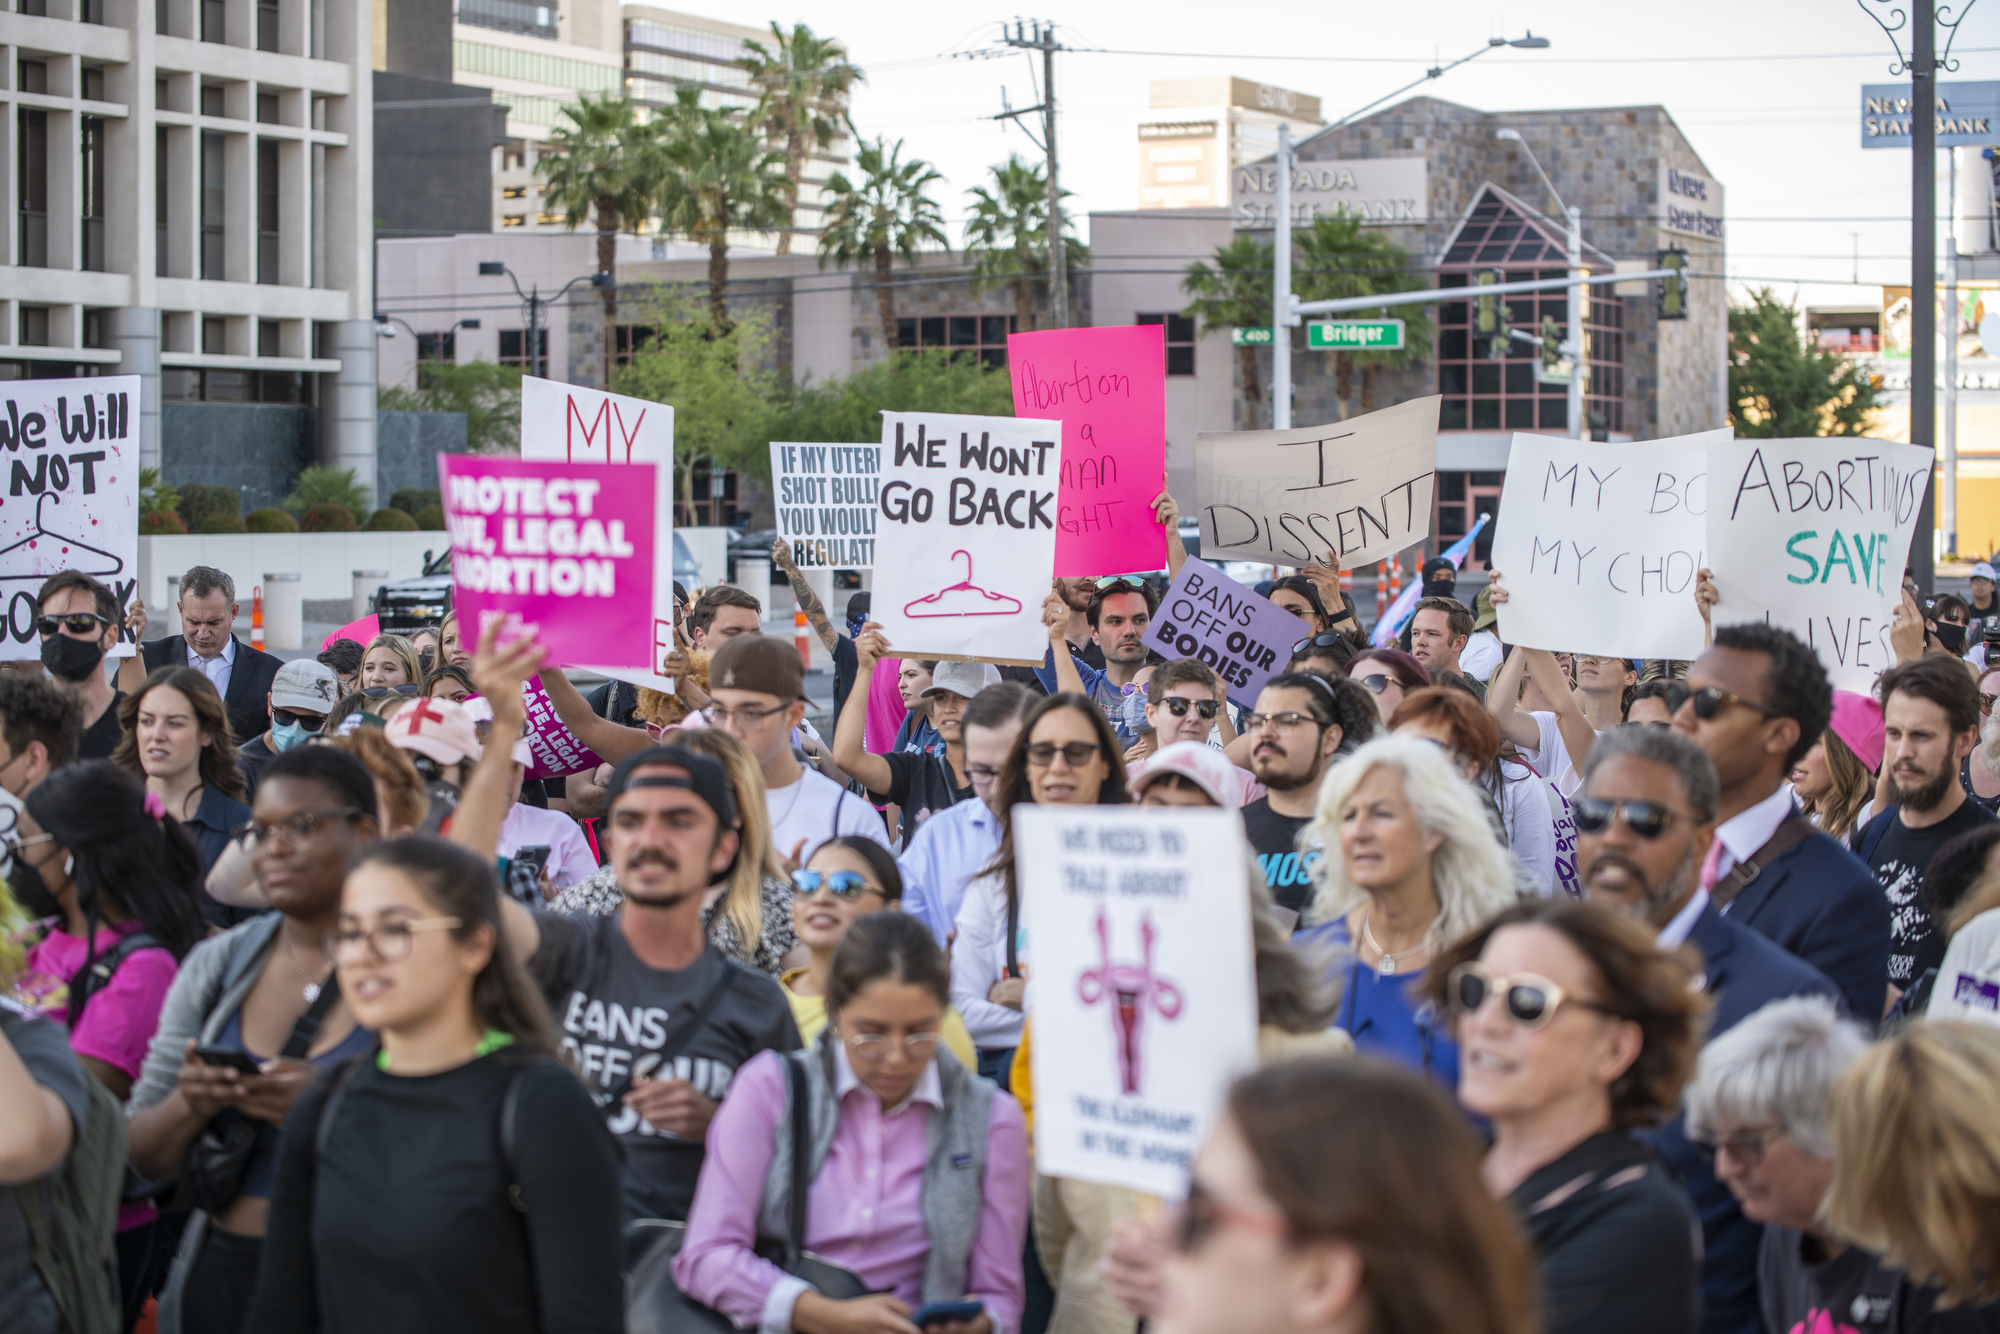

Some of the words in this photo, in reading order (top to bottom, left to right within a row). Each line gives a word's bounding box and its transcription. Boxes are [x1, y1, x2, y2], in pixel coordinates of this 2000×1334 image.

[1865, 97, 1950, 115] NEVA
[1865, 116, 1914, 137] STAT
[1237, 199, 1319, 227] STTE
[1246, 329, 1271, 342] 400
[1321, 323, 1384, 346] Bridger
[1021, 360, 1130, 410] Abortion
[57, 391, 128, 445] Will
[567, 393, 646, 465] MY
[781, 446, 797, 473] IF
[800, 446, 827, 474] MY
[831, 446, 881, 475] UTER
[894, 422, 947, 468] WE
[9, 450, 106, 497] NOT
[780, 476, 828, 505] SHOT
[1059, 455, 1117, 490] MAN
[1543, 460, 1621, 512] MY
[1645, 472, 1707, 516] BO
[1731, 447, 1929, 531] ABORTIONS
[780, 507, 815, 536] YOU
[880, 480, 934, 525] GO
[949, 477, 1054, 530] BACK
[1057, 500, 1124, 537] GHT
[1204, 471, 1434, 569] DISSENT
[446, 514, 498, 558] AFE,
[502, 517, 635, 558] LEGAL
[1531, 535, 1597, 586] MY
[1608, 550, 1703, 597] CHOI
[1786, 528, 1888, 598] SAVE
[1183, 573, 1256, 627] BANS
[1156, 620, 1253, 689] BODIES
[1172, 599, 1227, 638] OFF
[1226, 631, 1277, 673] OUR
[1766, 610, 1890, 676] IVES
[521, 708, 566, 773] ORTION
[545, 730, 584, 770] LEGAL
